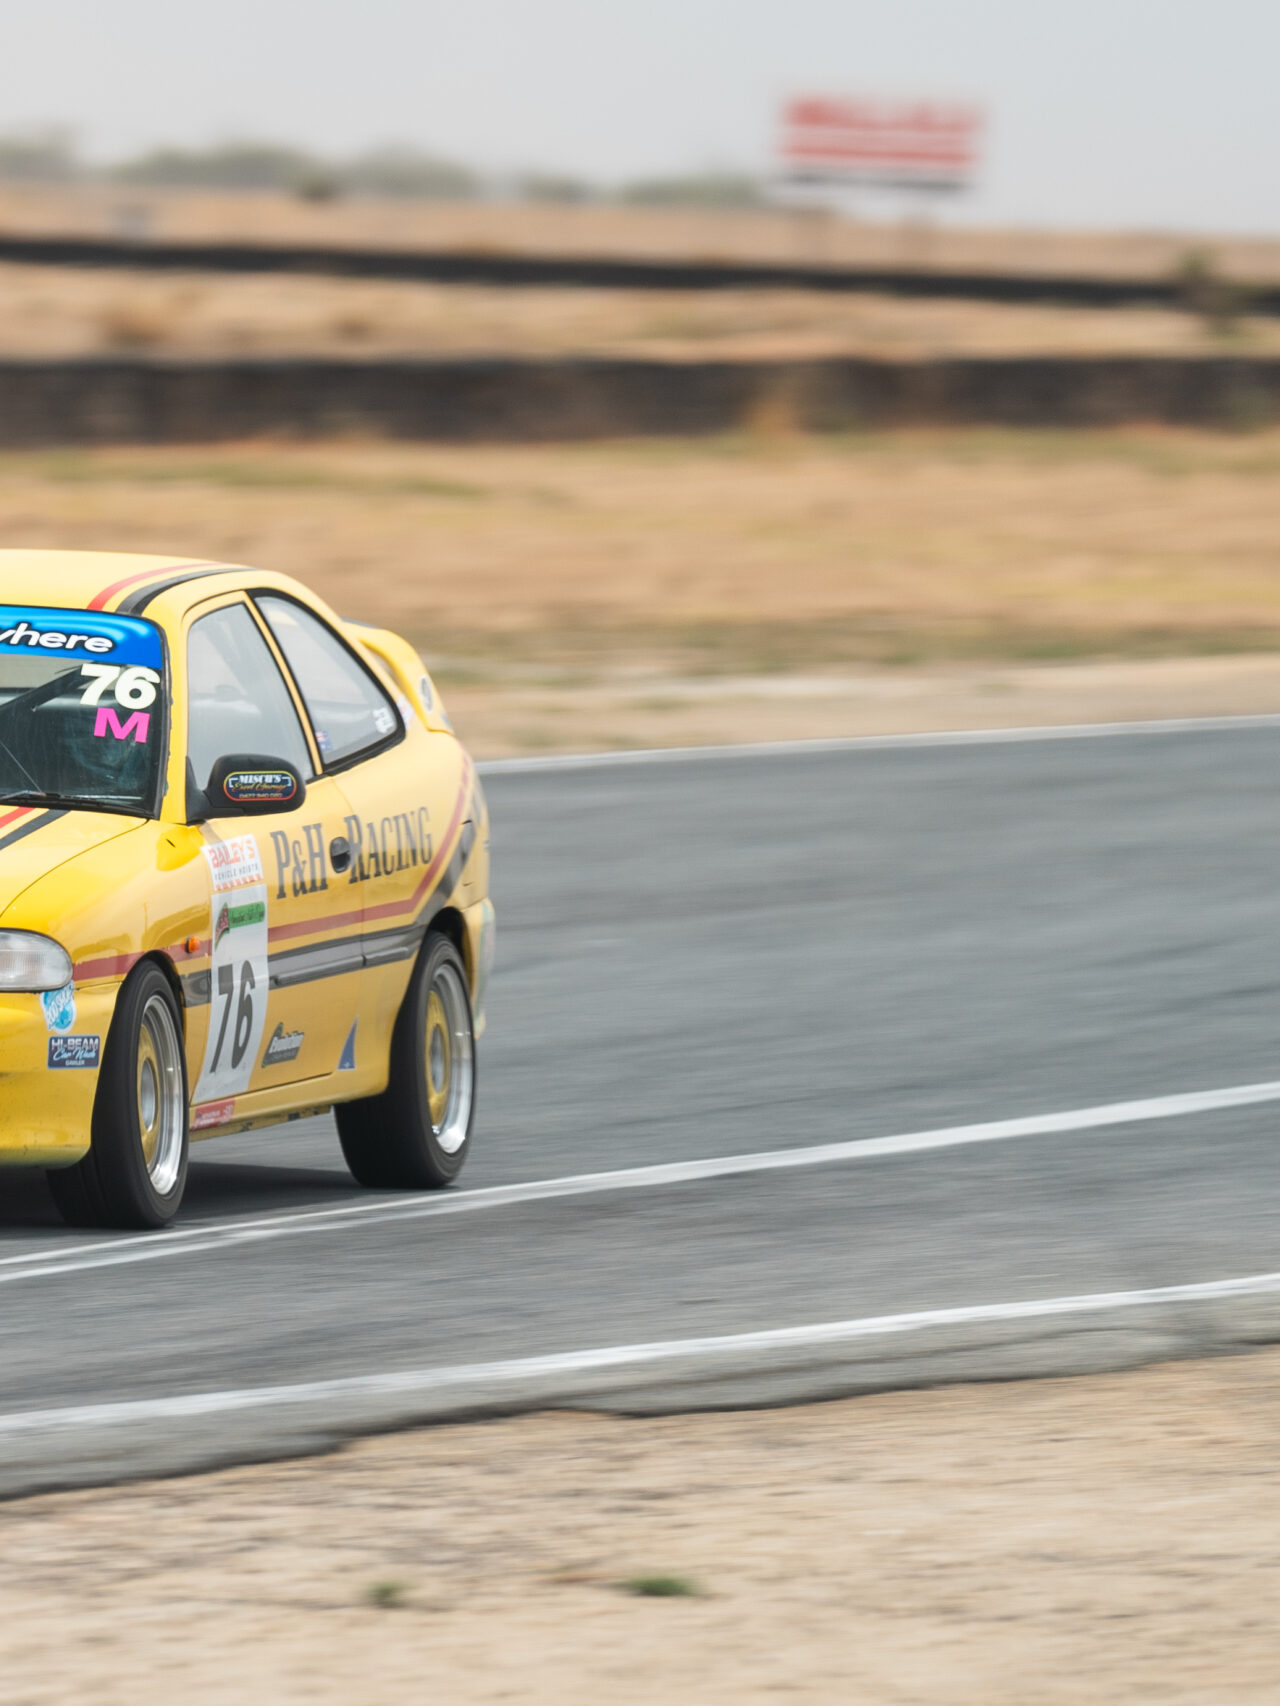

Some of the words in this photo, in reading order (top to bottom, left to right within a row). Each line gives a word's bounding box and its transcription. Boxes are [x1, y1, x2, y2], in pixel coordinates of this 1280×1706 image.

[79, 663, 160, 709] 76
[93, 707, 151, 743] M
[270, 823, 328, 899] P&H
[344, 807, 432, 884] RACING
[209, 960, 255, 1073] 76
[51, 1038, 98, 1050] HI-BEAM
[53, 1048, 72, 1061] Car
